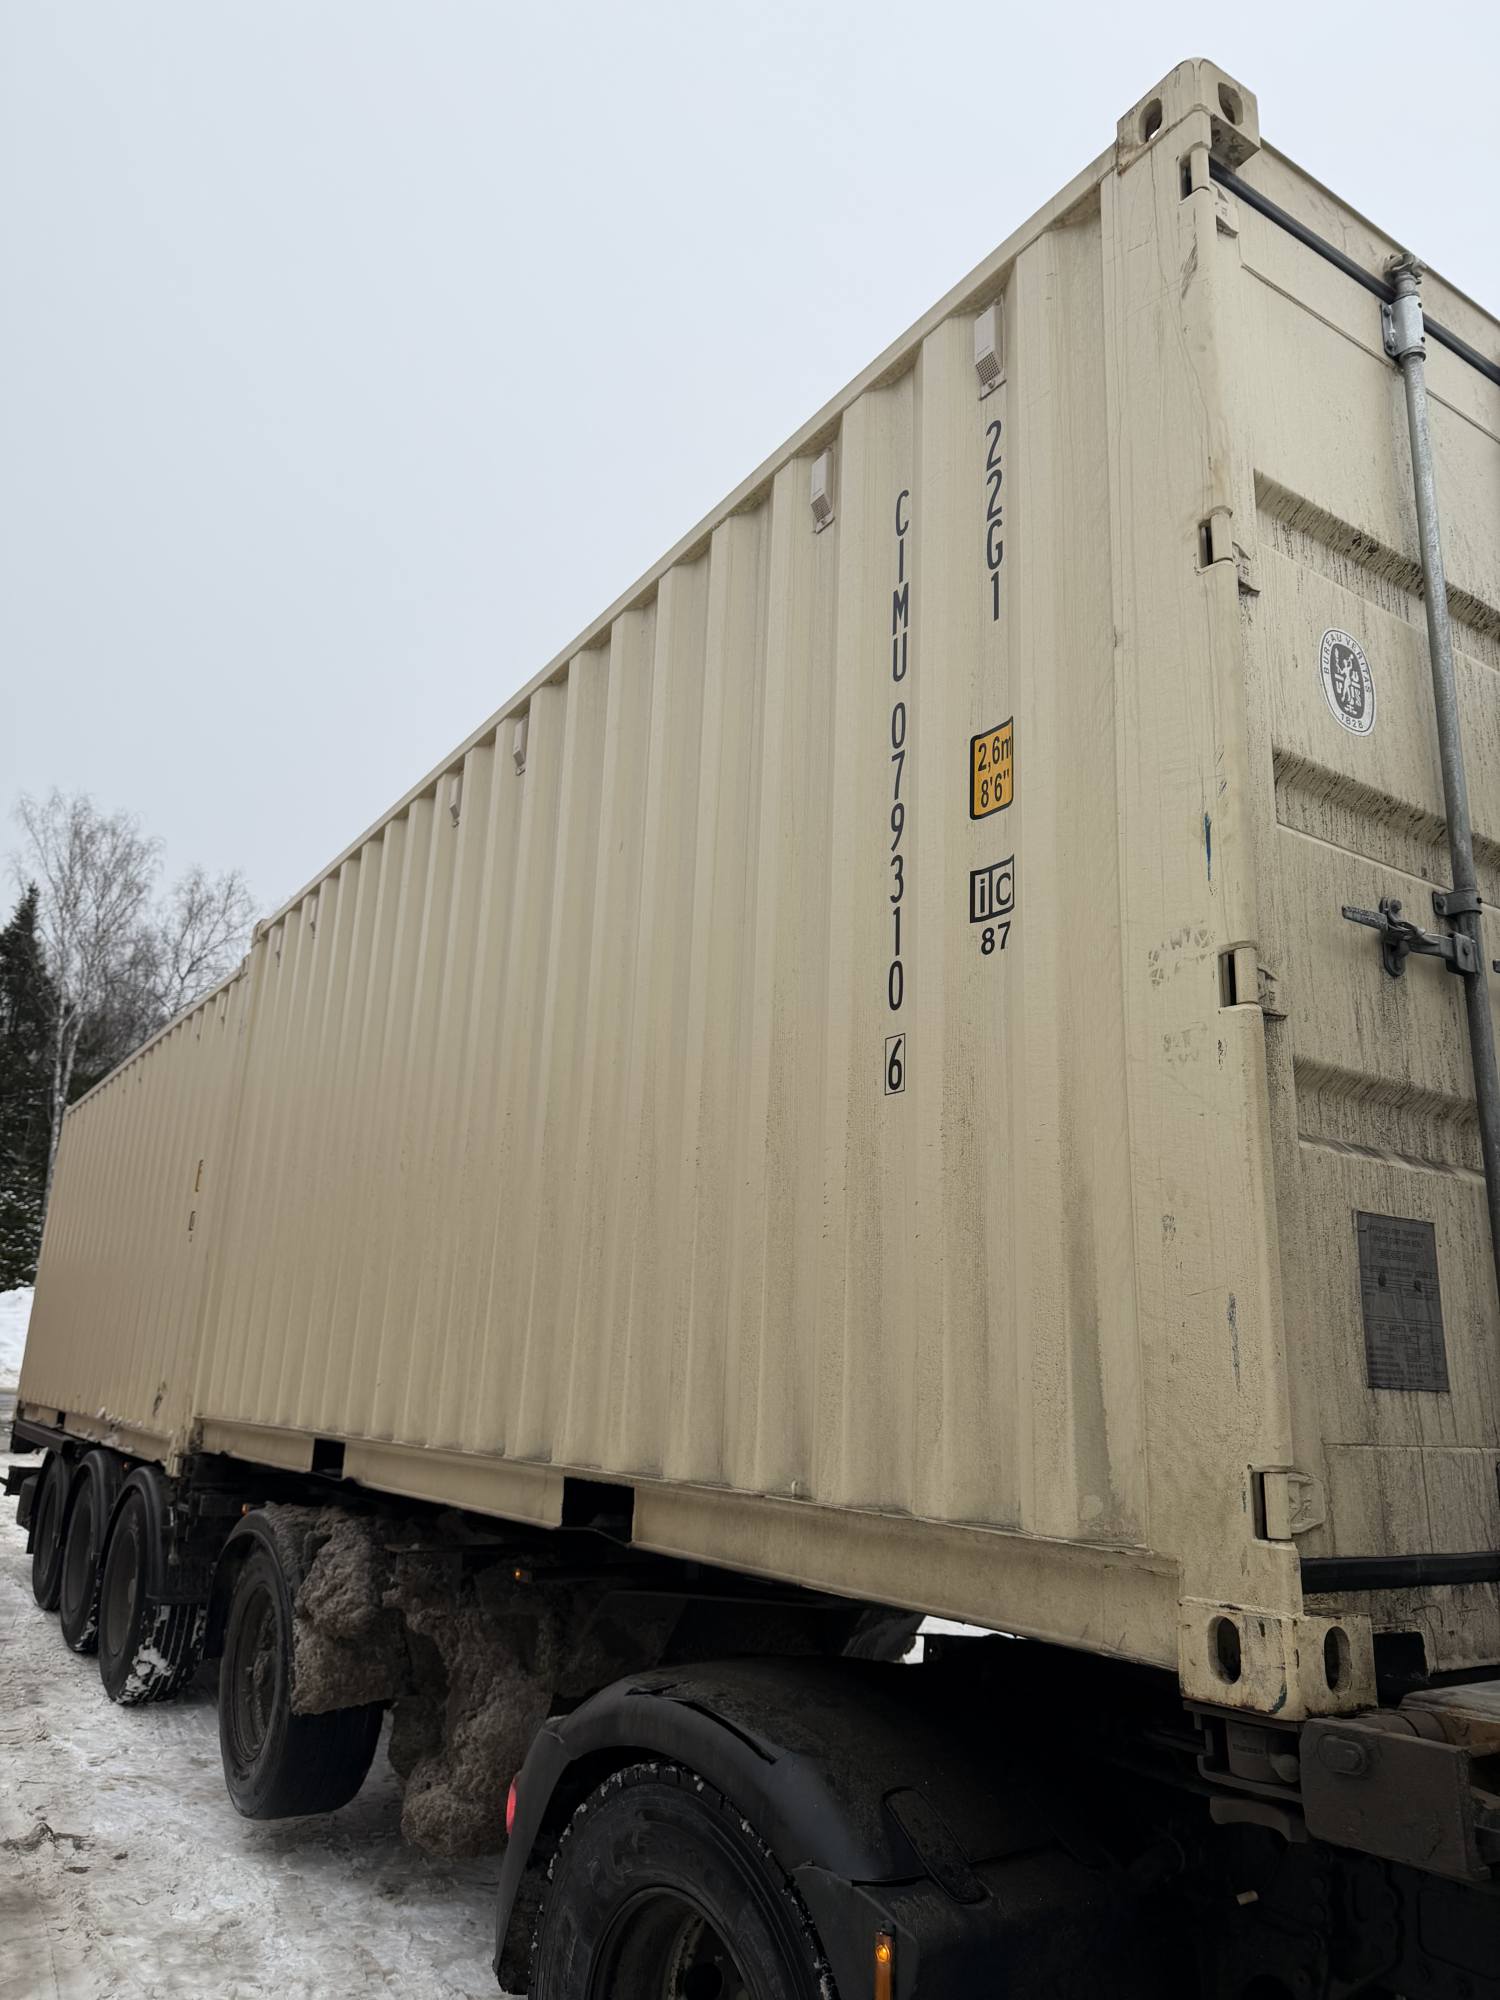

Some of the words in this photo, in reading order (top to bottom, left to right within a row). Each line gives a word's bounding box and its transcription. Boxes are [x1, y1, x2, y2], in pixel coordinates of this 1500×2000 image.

[985, 419, 1004, 622] 22G1
[892, 489, 910, 682] CIMU
[1323, 633, 1342, 675] BUREAU
[1345, 637, 1372, 693] VERITAS
[1339, 713, 1364, 729] 1828
[977, 735, 1012, 773] 2,6m
[980, 768, 1010, 808] 8'6"
[888, 701, 906, 1011] 079310
[980, 920, 1011, 956] 87
[887, 1038, 903, 1091] 6
